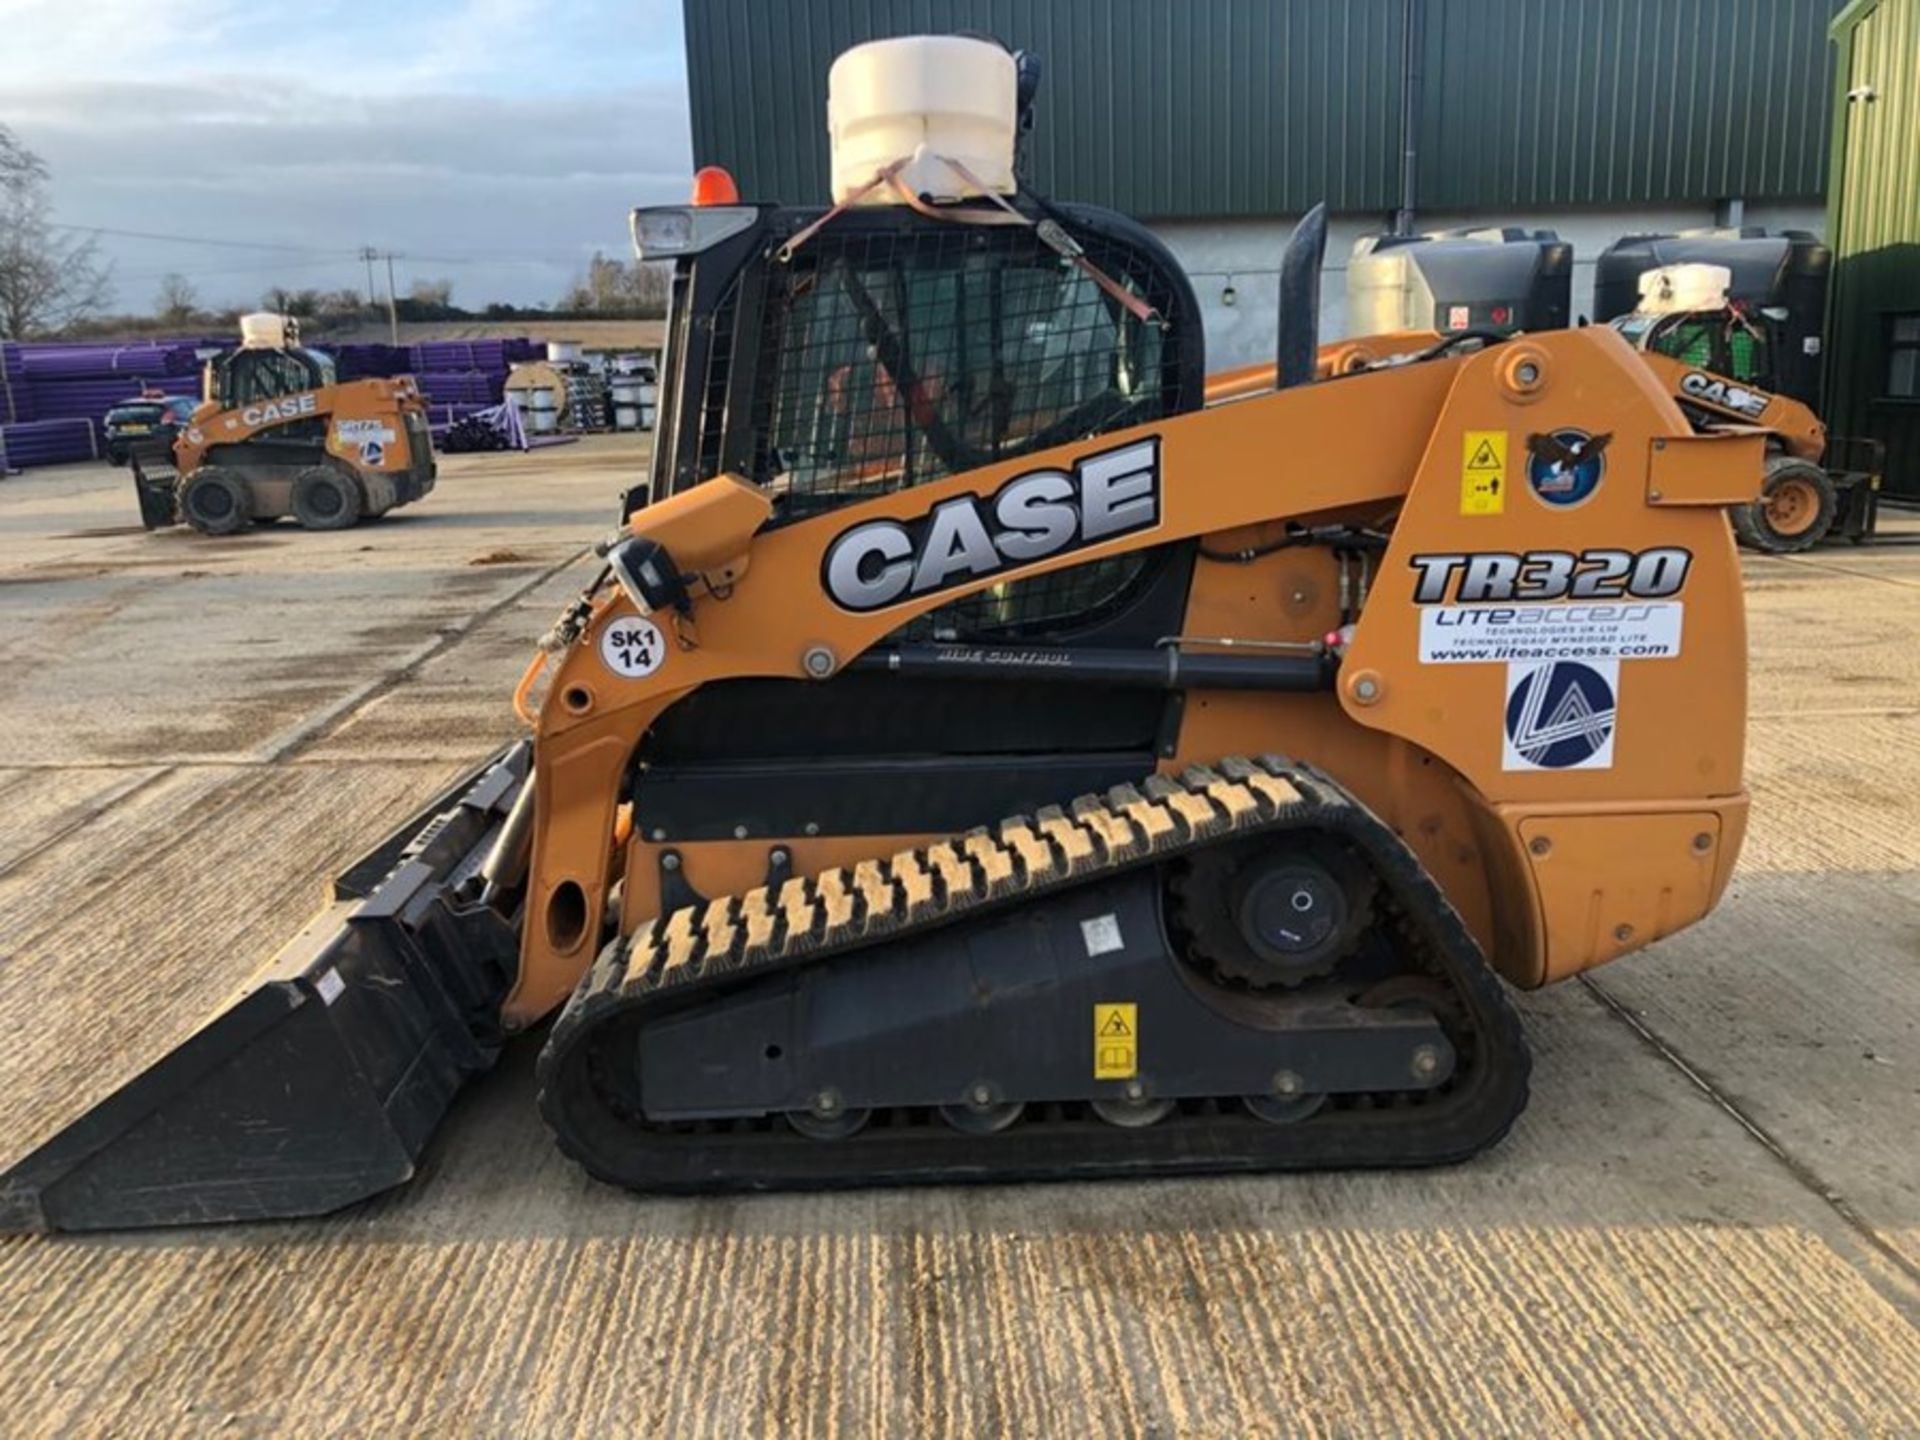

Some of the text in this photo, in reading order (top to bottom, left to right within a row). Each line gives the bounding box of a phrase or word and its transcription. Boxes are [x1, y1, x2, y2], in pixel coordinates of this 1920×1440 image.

[243, 394, 315, 426] CASE
[826, 438, 1157, 610] CASE
[1411, 547, 1692, 603] TR320
[611, 630, 656, 647] SK1
[1430, 643, 1670, 660] www.liteaccess.com
[619, 648, 652, 668] 14
